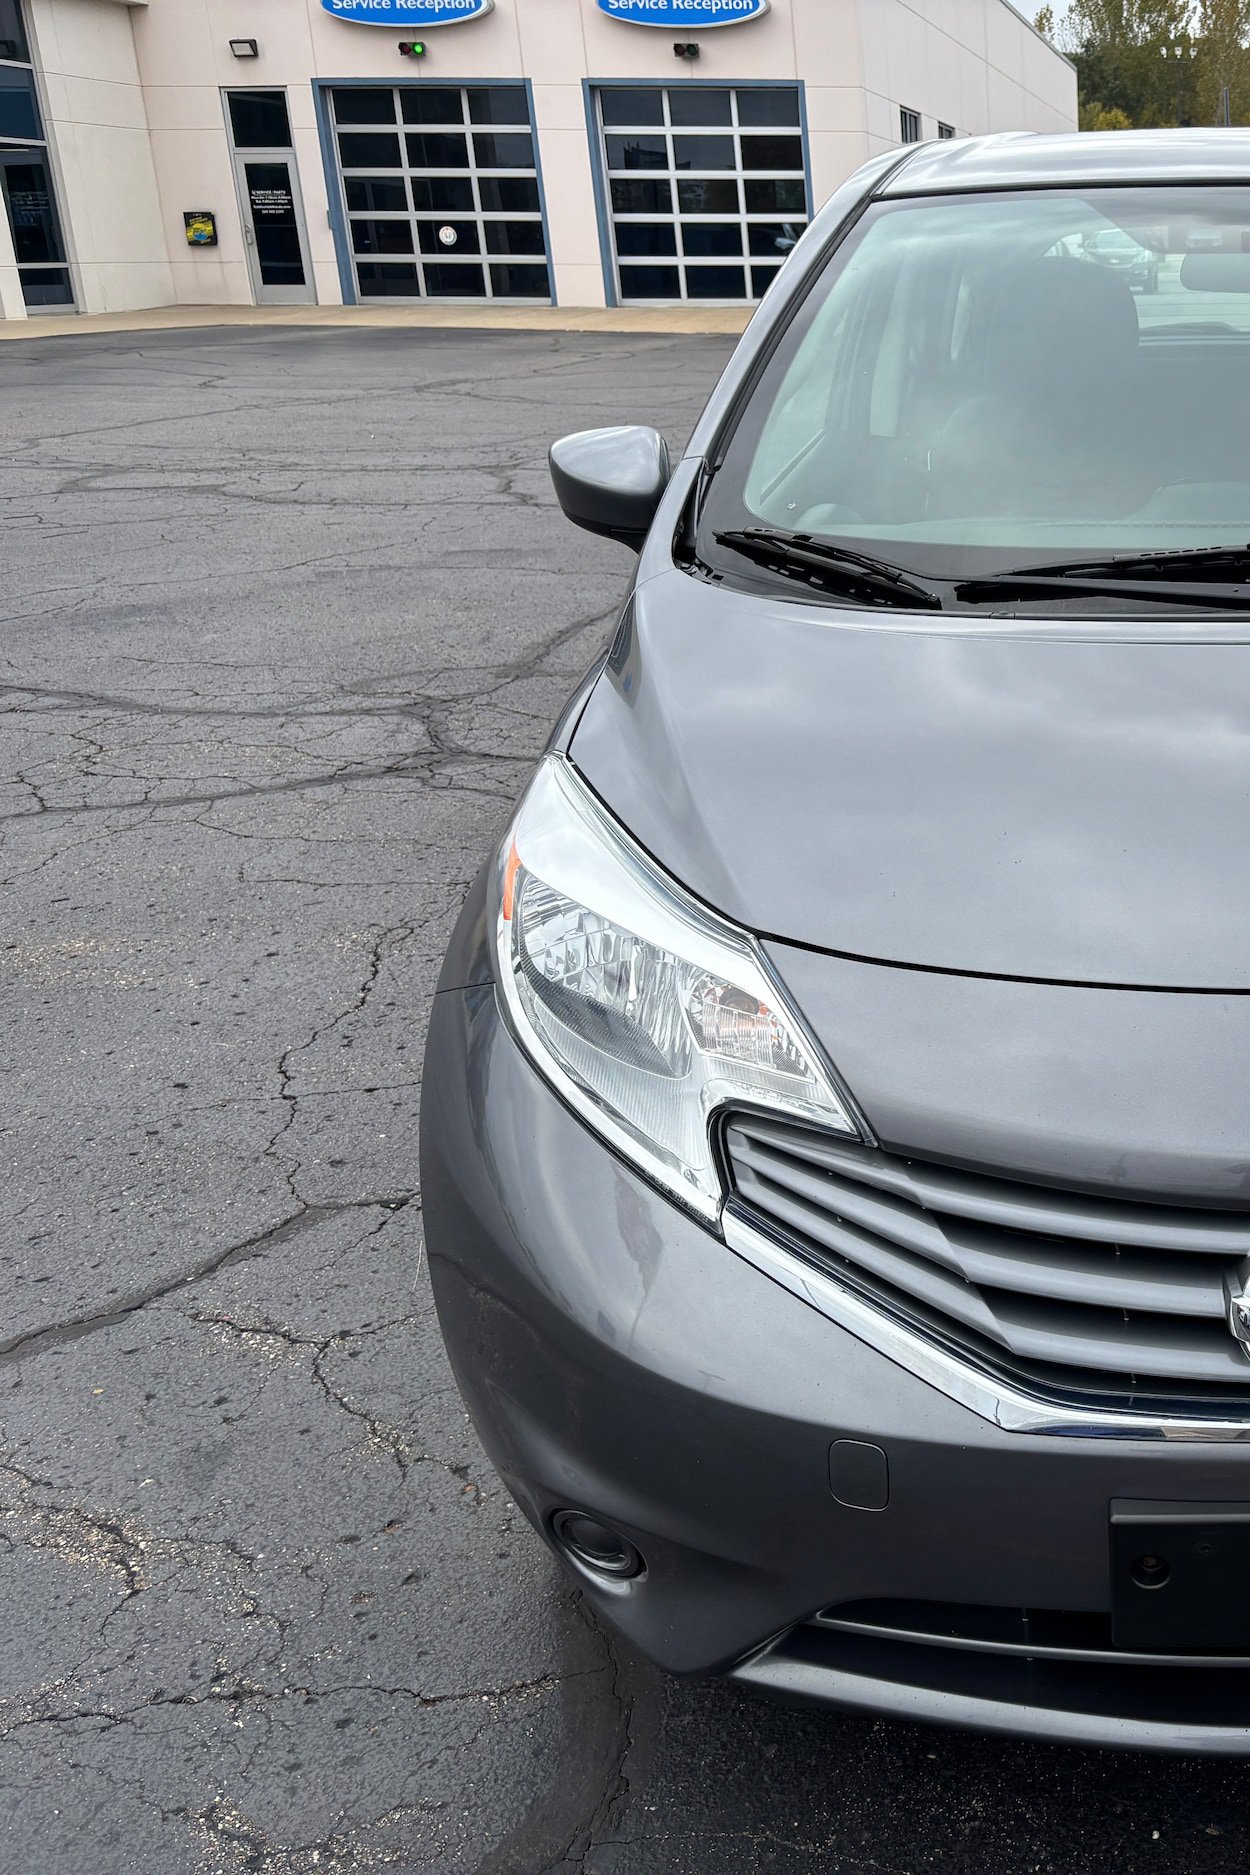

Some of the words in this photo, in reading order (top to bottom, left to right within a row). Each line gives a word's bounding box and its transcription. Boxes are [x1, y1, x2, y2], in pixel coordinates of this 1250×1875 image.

[332, 0, 391, 9] Service
[396, 0, 476, 13] Reception
[608, 0, 668, 9] Service
[672, 0, 754, 14] Reception
